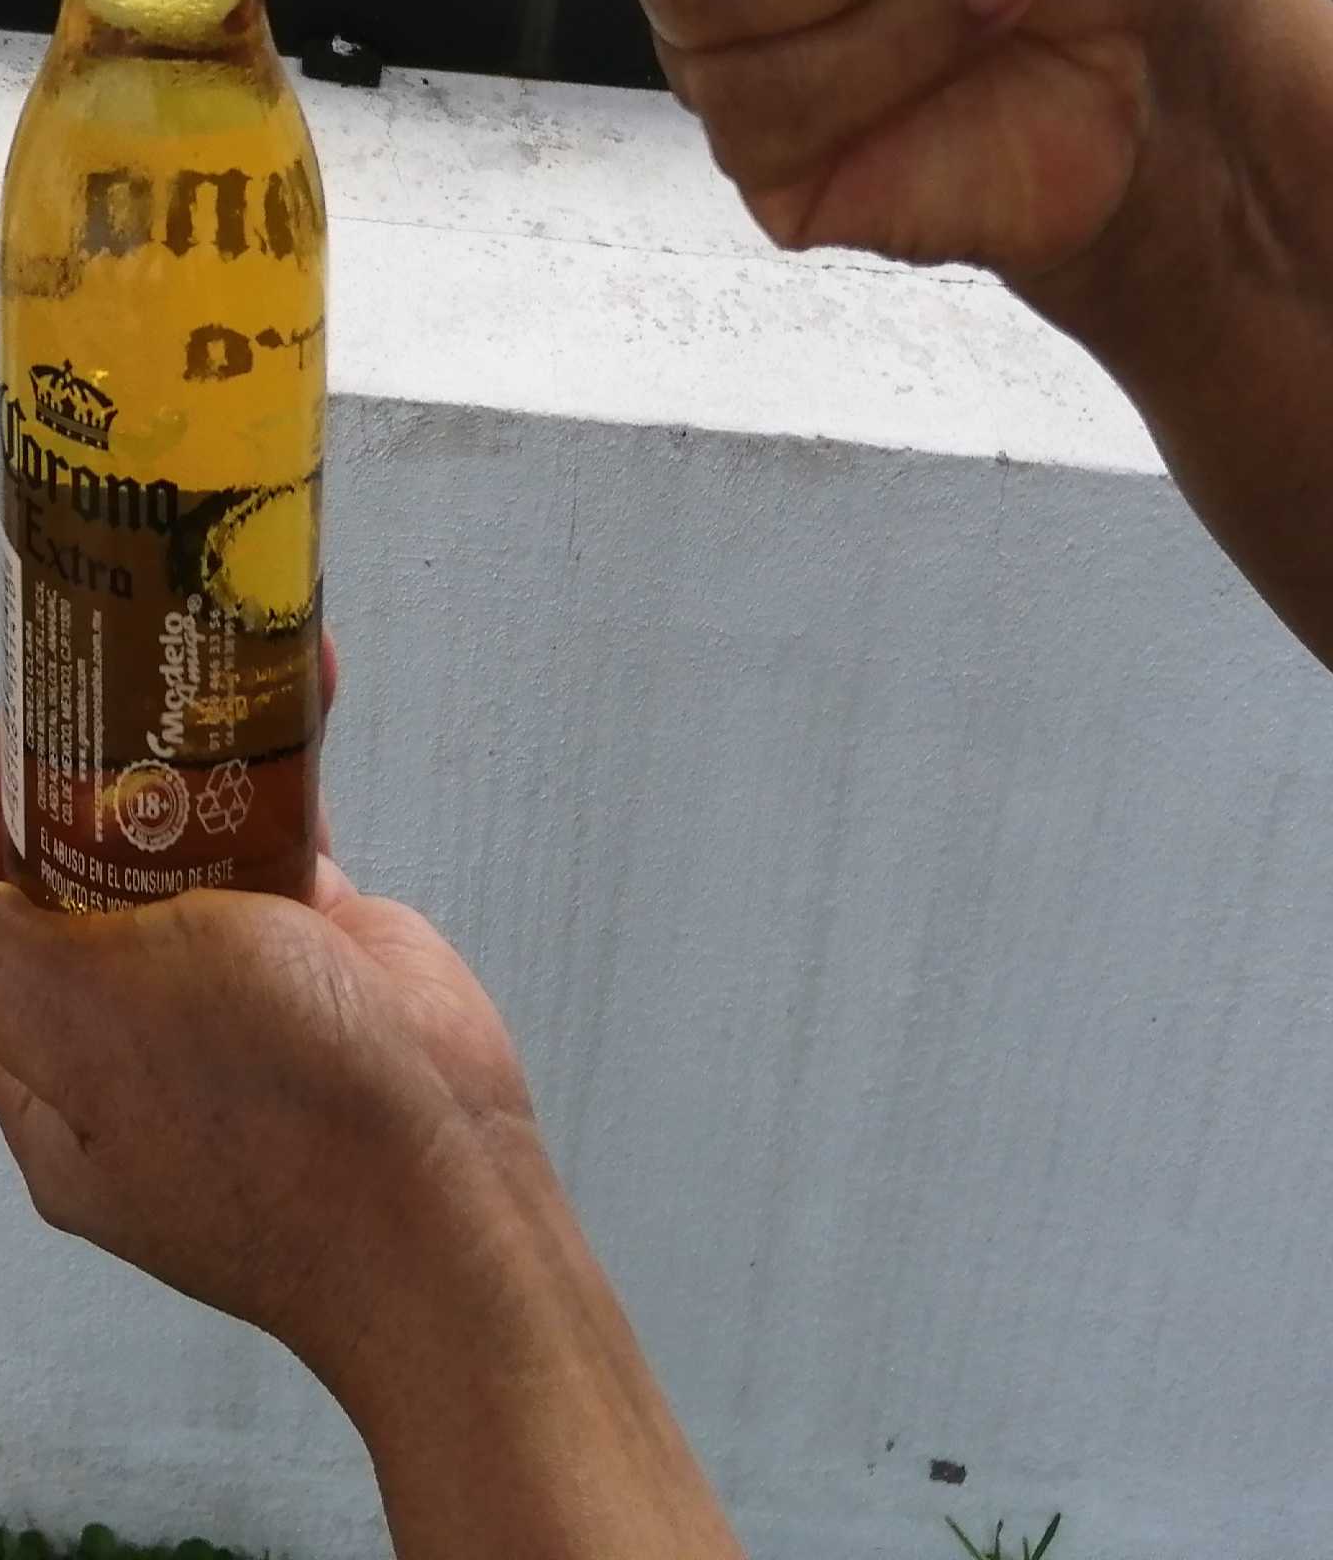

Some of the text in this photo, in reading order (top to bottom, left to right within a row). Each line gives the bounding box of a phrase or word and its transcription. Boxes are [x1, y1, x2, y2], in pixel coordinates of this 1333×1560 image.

[0, 383, 180, 536] Corona
[25, 496, 134, 600] Extra
[146, 611, 185, 759] Modelo
[176, 614, 206, 704] Amigo
[40, 826, 51, 855] EL
[53, 837, 86, 876] ABUSO
[89, 856, 104, 884] EN
[107, 862, 121, 889] EL
[124, 867, 183, 896] CONSUMO
[207, 856, 235, 888] ESTE
[40, 858, 88, 914] PRODUCTO
